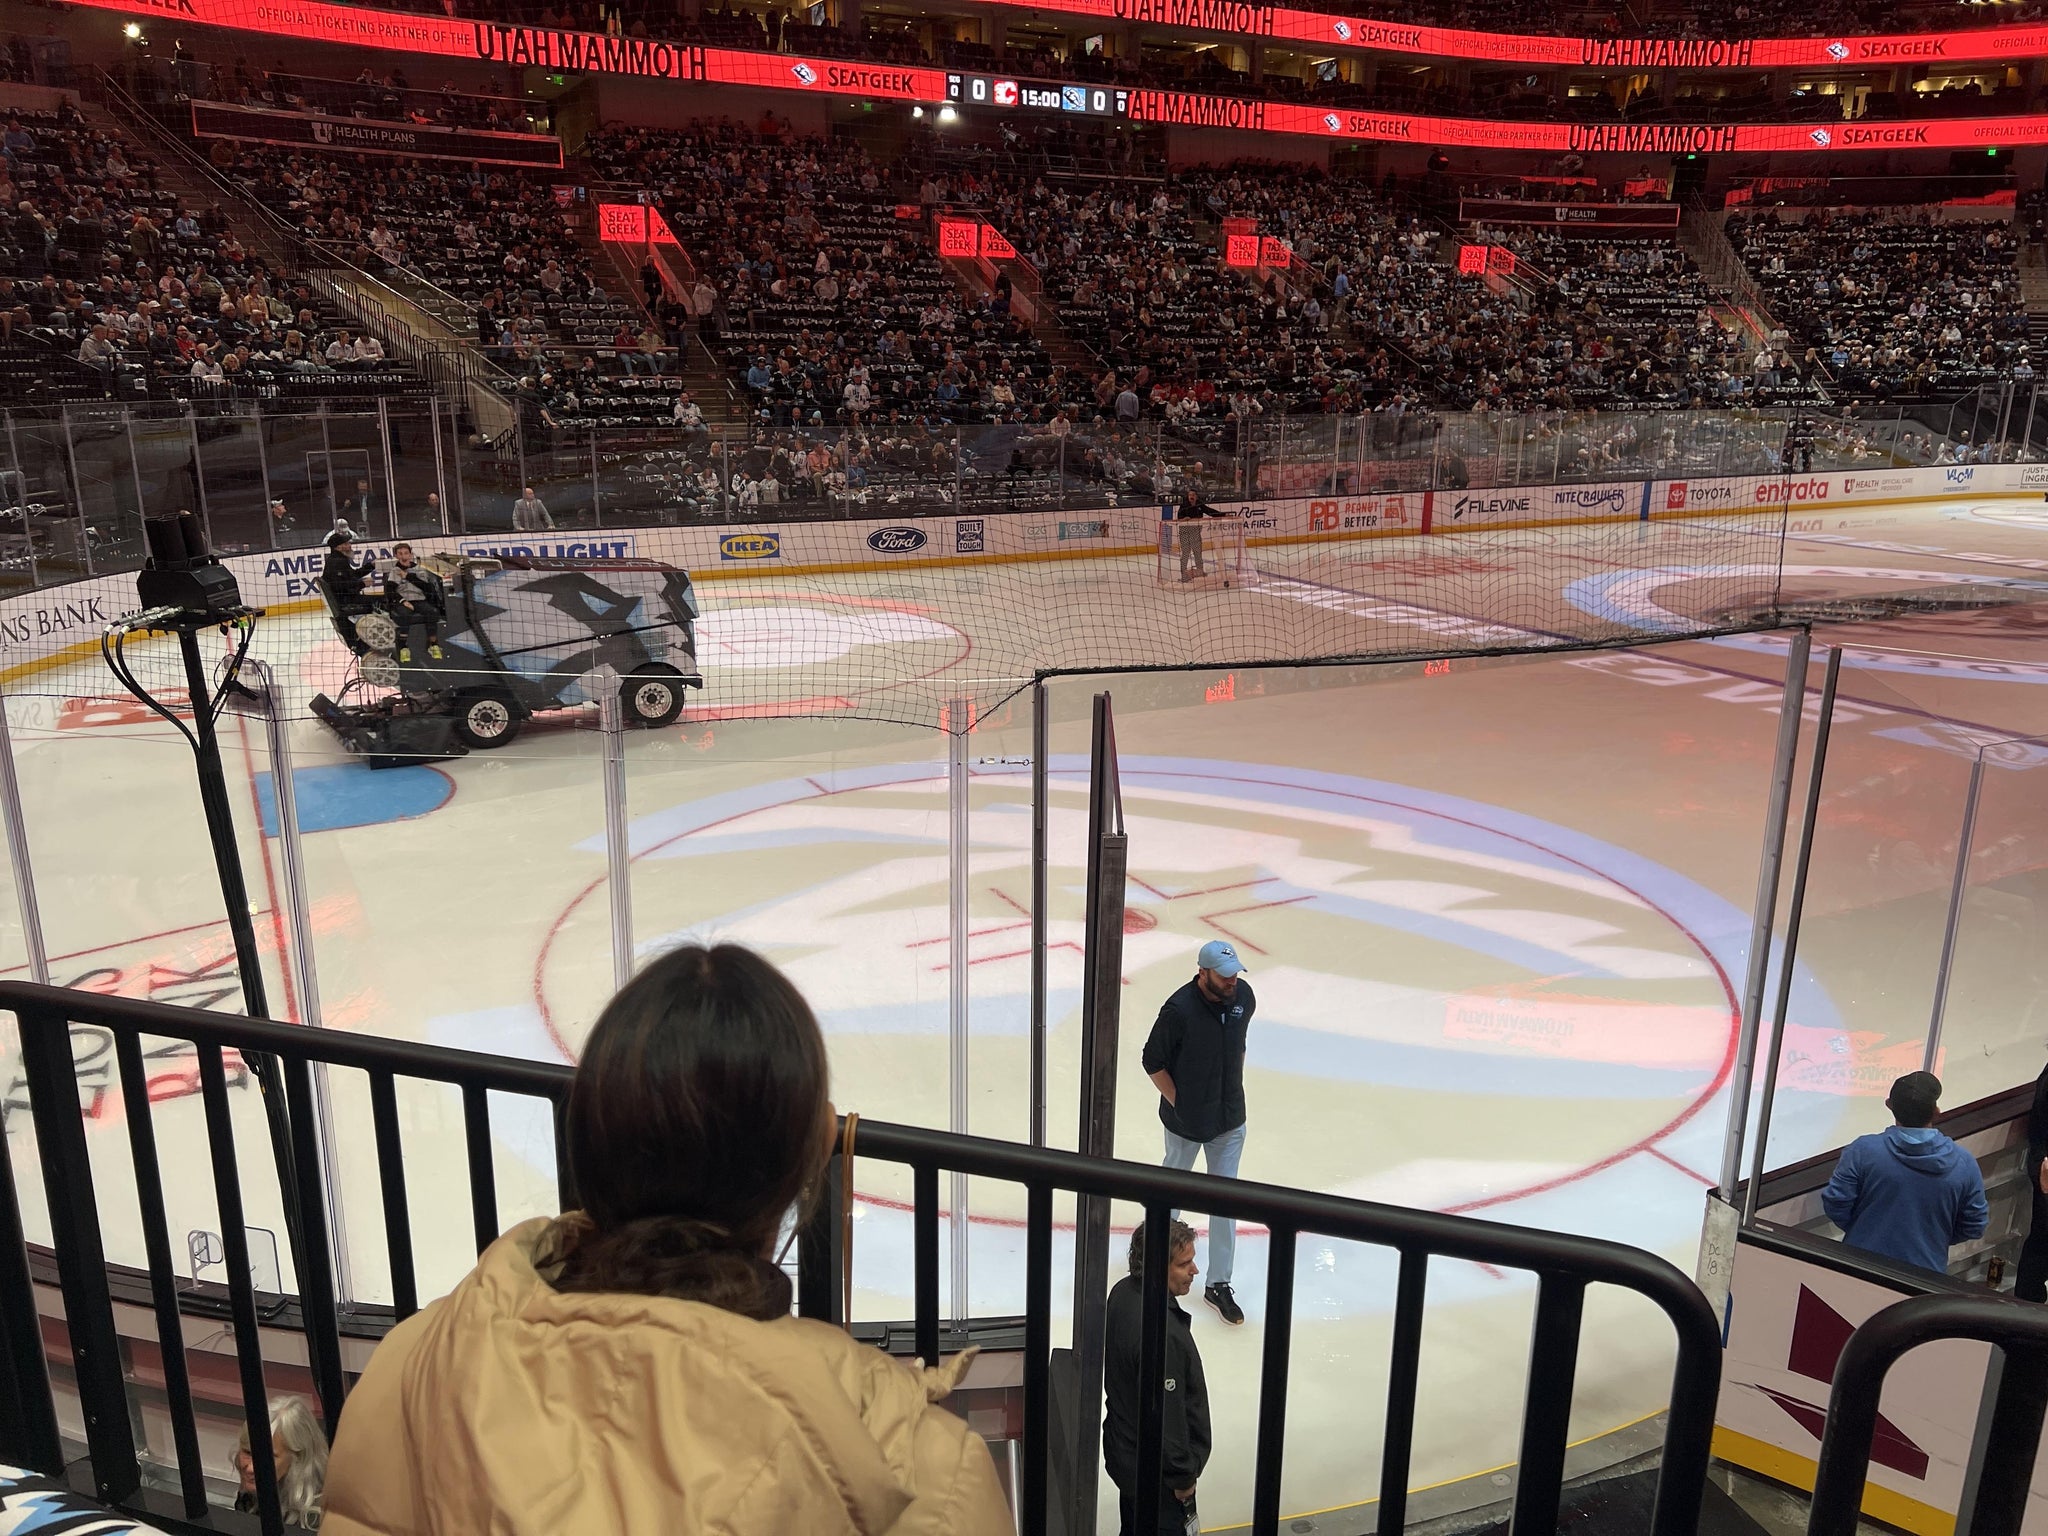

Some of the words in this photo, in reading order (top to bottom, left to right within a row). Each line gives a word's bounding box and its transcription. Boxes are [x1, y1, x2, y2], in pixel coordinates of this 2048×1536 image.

[1113, 0, 1166, 23] UTAH
[1172, 0, 1274, 36] MAMMOTH
[257, 6, 312, 25] OFFICIAL
[314, 14, 375, 34] TICKETING
[378, 22, 430, 41] PARTNER
[432, 30, 447, 43] OF
[450, 33, 470, 46] THE
[474, 24, 550, 66] UTAH
[557, 35, 706, 80] MAMMOTH
[1359, 24, 1422, 48] SEATGEEK
[1454, 38, 1484, 50] OFFICIAL
[1486, 41, 1521, 53] TICKETING
[1523, 43, 1554, 55] PARTNER
[1556, 45, 1565, 55] OF
[1567, 46, 1580, 56] THE
[1582, 39, 1634, 65] UTAH
[1638, 40, 1753, 66] MAMMOTH
[1859, 38, 1947, 58] SEATGEEK
[1993, 37, 2035, 49] OFFICIAL
[828, 66, 914, 94] SEATGEEK
[950, 85, 959, 97] 0
[972, 79, 986, 100] 0
[1021, 88, 1060, 107] 15:00
[1093, 91, 1106, 111] 0
[1117, 100, 1126, 112] 0
[1164, 94, 1264, 129] MAMMOTH
[1349, 115, 1411, 137] SEATGEEK
[1443, 126, 1472, 137] OFFICIAL
[1474, 129, 1508, 139] TICKETING
[1509, 130, 1541, 141] PARTNER
[1543, 131, 1552, 141] OF
[1554, 132, 1567, 141] THE
[1569, 125, 1619, 151] UTAH
[1625, 125, 1737, 151] MAMMOTH
[1842, 125, 1930, 145] SEATGEEK
[1974, 125, 2015, 137] OFFICIAL
[336, 126, 378, 139] HEALTH
[381, 129, 416, 144] PLANS
[607, 211, 637, 223] SEAT
[1569, 210, 1596, 218] HEALTH
[607, 223, 639, 236] GEEK
[946, 228, 971, 240] SEAT
[945, 239, 971, 251] GEEK
[1233, 240, 1252, 250] SEAT
[1232, 250, 1253, 260] GEEK
[2026, 466, 2044, 474] JUST
[1756, 478, 1829, 502] entrata
[1856, 480, 1880, 489] HEALTH
[1555, 489, 1624, 511] NITECRAWLER
[1690, 487, 1731, 501] TOYOTA
[1344, 501, 1379, 514] PEANUT
[1469, 498, 1530, 514] FILEVINE
[960, 523, 981, 532] BUILT
[1069, 523, 1089, 533] G2G
[1251, 519, 1278, 529] FIRST
[1344, 515, 1378, 528] BETTER
[878, 528, 916, 549] Ford
[726, 541, 775, 552] IKEA
[960, 542, 980, 550] TOUGH
[265, 548, 395, 578] AMECAN
[36, 596, 108, 637] BANK
